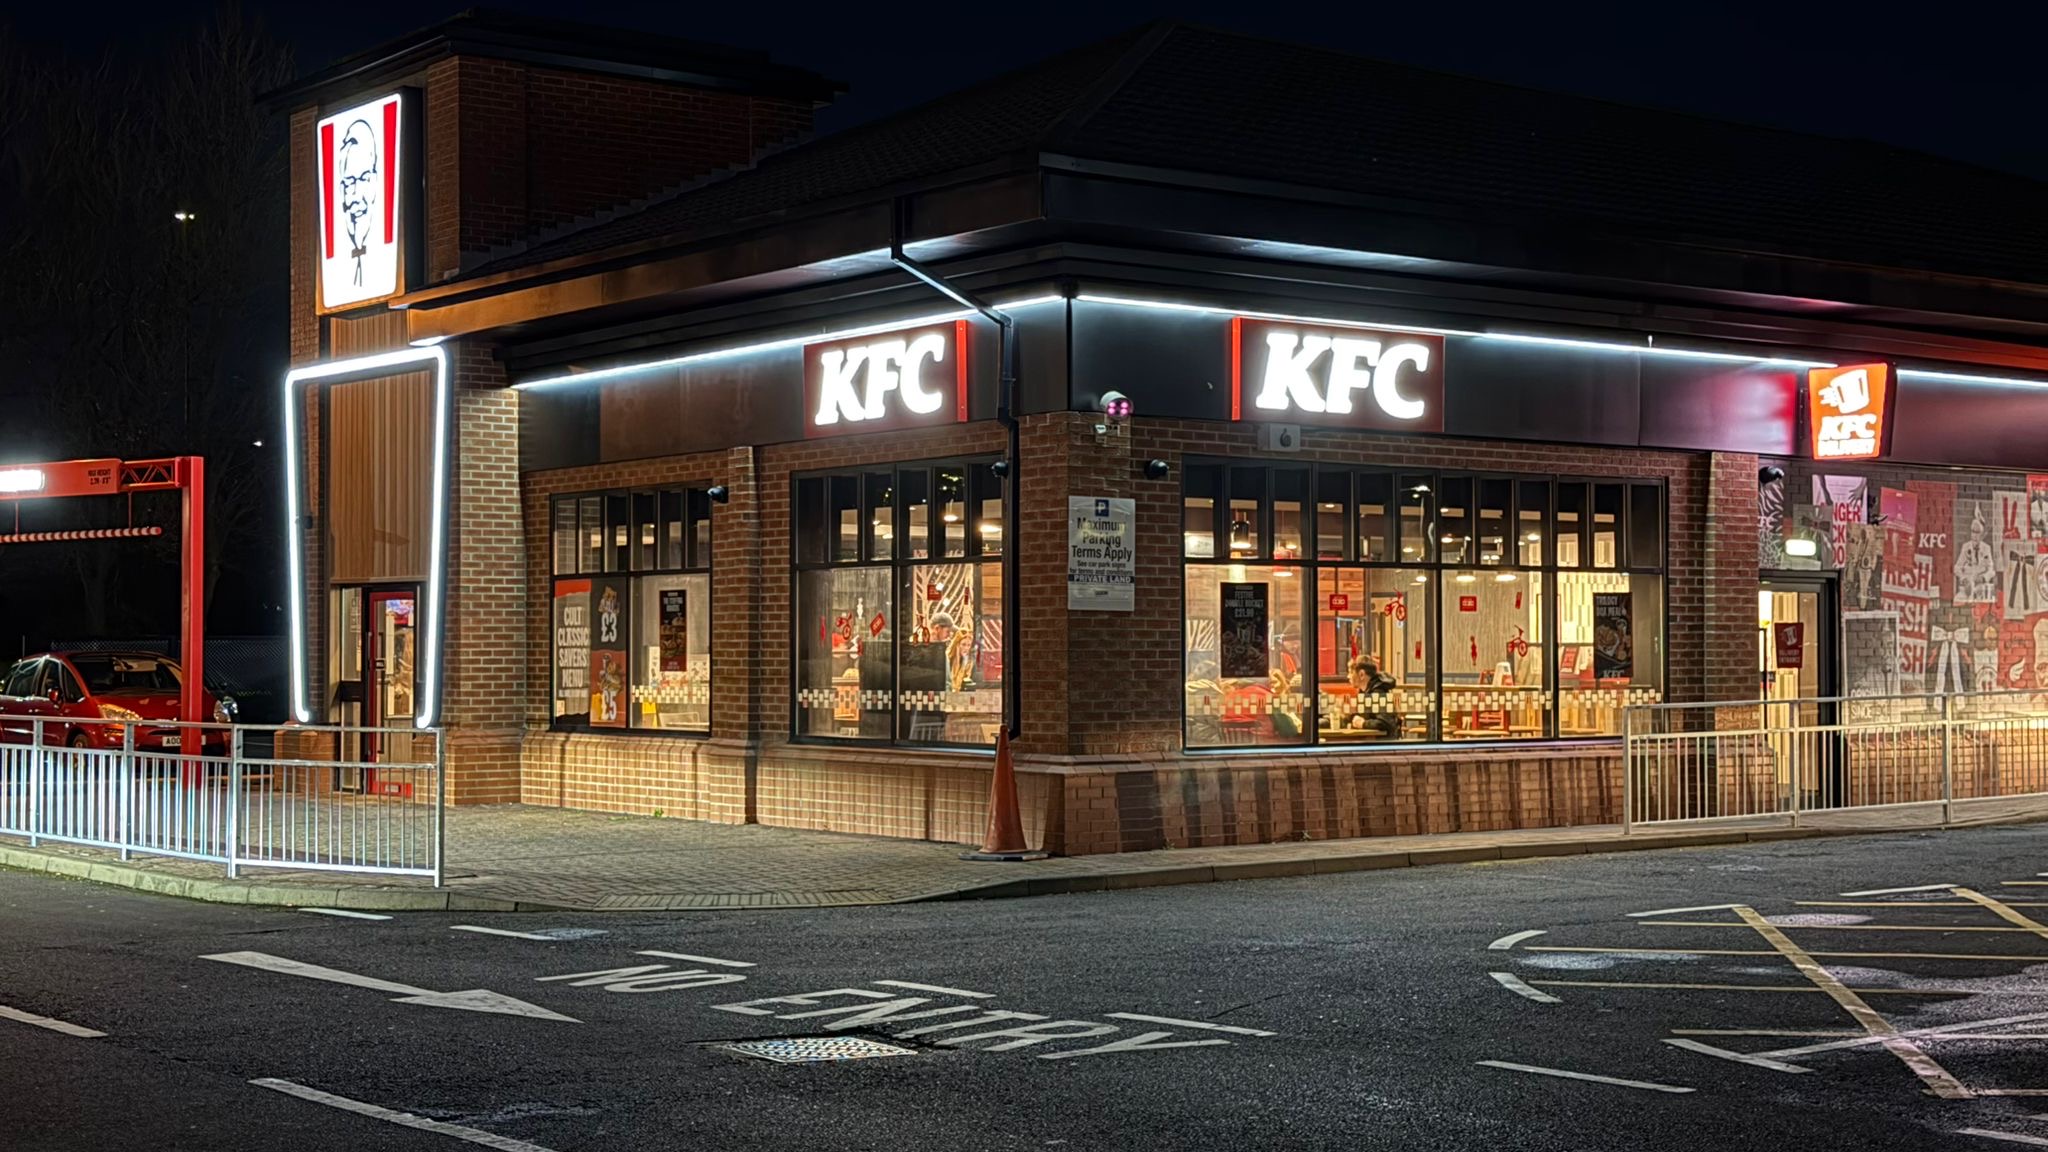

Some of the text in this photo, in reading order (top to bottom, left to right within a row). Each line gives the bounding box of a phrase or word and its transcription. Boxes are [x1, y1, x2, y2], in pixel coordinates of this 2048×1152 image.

[814, 334, 945, 427] KFC
[1255, 332, 1430, 419] KFC
[1819, 414, 1877, 440] KFC
[1077, 517, 1126, 531] Maximum
[1083, 531, 1121, 547] Parking
[1918, 533, 1946, 548] KFC
[1072, 545, 1132, 562] Terms Apply
[1098, 561, 1110, 569] park
[1111, 562, 1126, 570] signs
[1074, 574, 1107, 583] PRIVATE
[1596, 596, 1618, 605] TRILOGY
[564, 606, 582, 626] CULT
[558, 627, 590, 647] CLASSIC
[601, 612, 617, 642] £3
[559, 648, 588, 668] SAVERS
[562, 668, 583, 688] MENU
[1603, 670, 1624, 678] KFC
[601, 690, 617, 720] £5
[534, 964, 748, 993] NO
[710, 987, 1232, 1060] ENTRY
